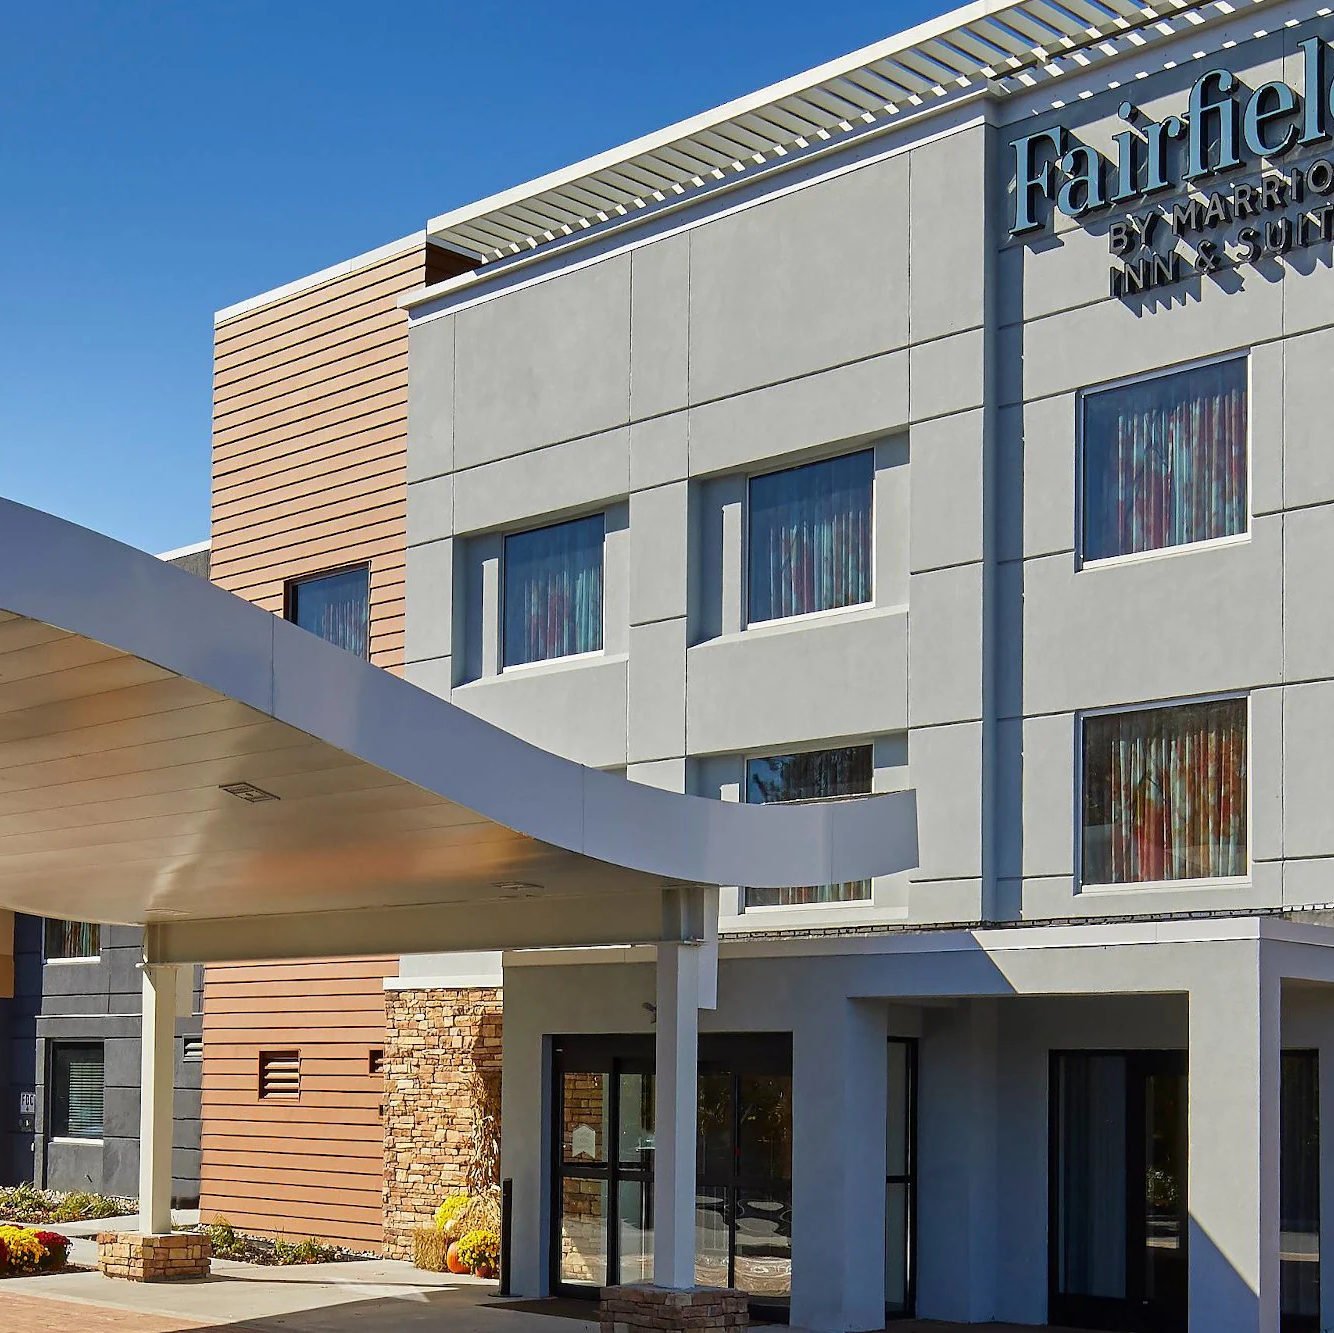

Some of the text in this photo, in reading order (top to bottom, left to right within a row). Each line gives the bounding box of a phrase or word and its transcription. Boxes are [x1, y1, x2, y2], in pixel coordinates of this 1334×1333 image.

[1109, 211, 1161, 254] BY
[1110, 249, 1180, 299] INN
[1194, 240, 1222, 274] &
